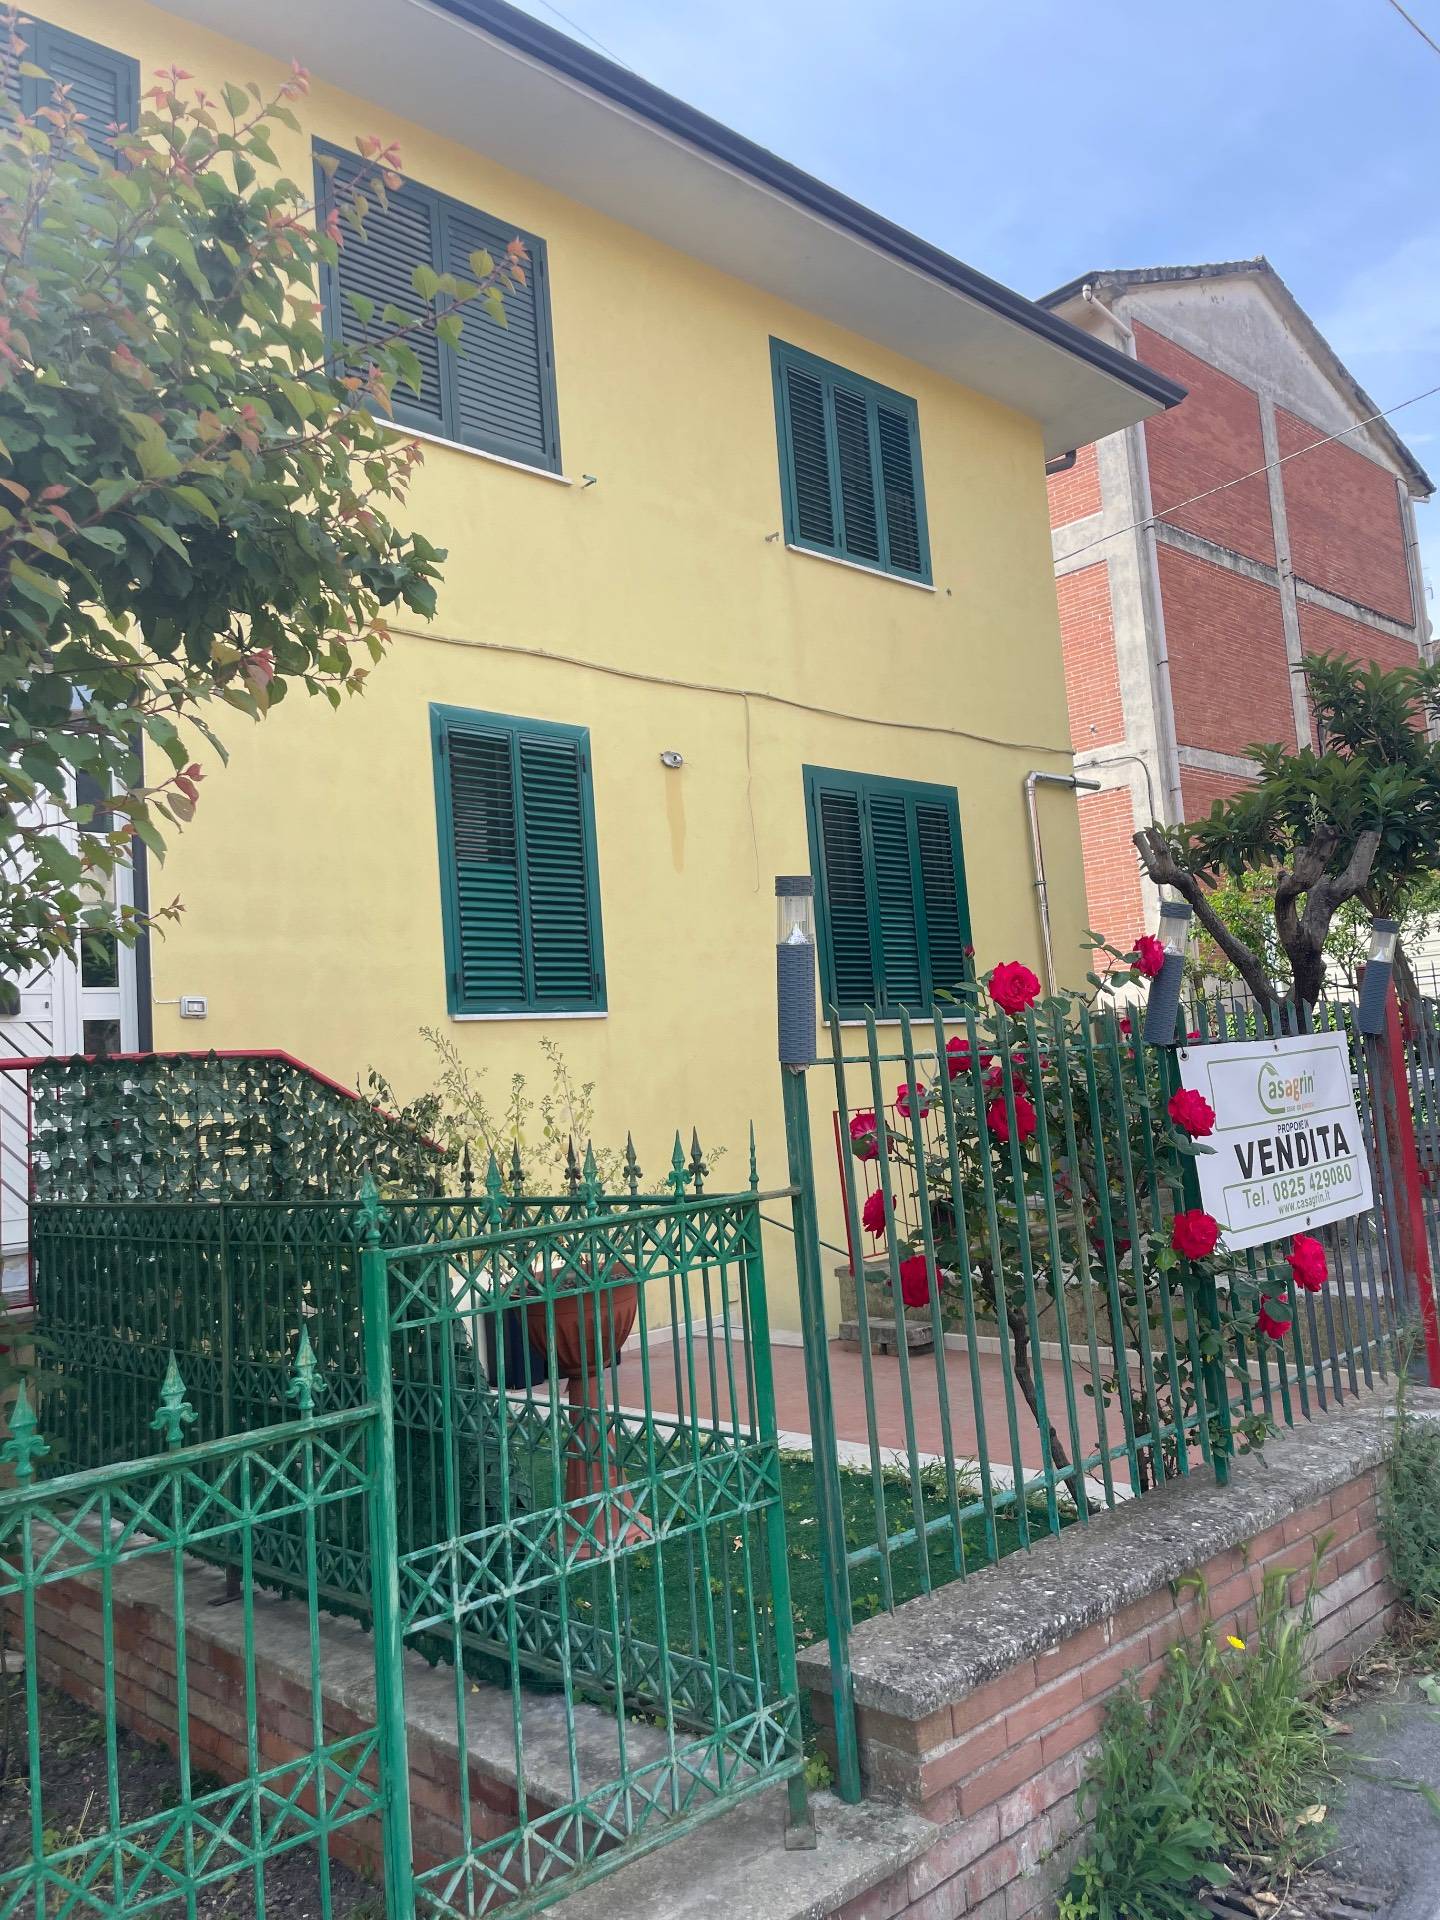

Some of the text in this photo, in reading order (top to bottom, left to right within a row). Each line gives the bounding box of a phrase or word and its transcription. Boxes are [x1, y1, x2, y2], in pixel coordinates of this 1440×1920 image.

[1234, 1123, 1350, 1179] VENDITA
[1242, 1163, 1352, 1209] Tel. 0825 429080
[1279, 1190, 1331, 1215] www.casagrin.it
